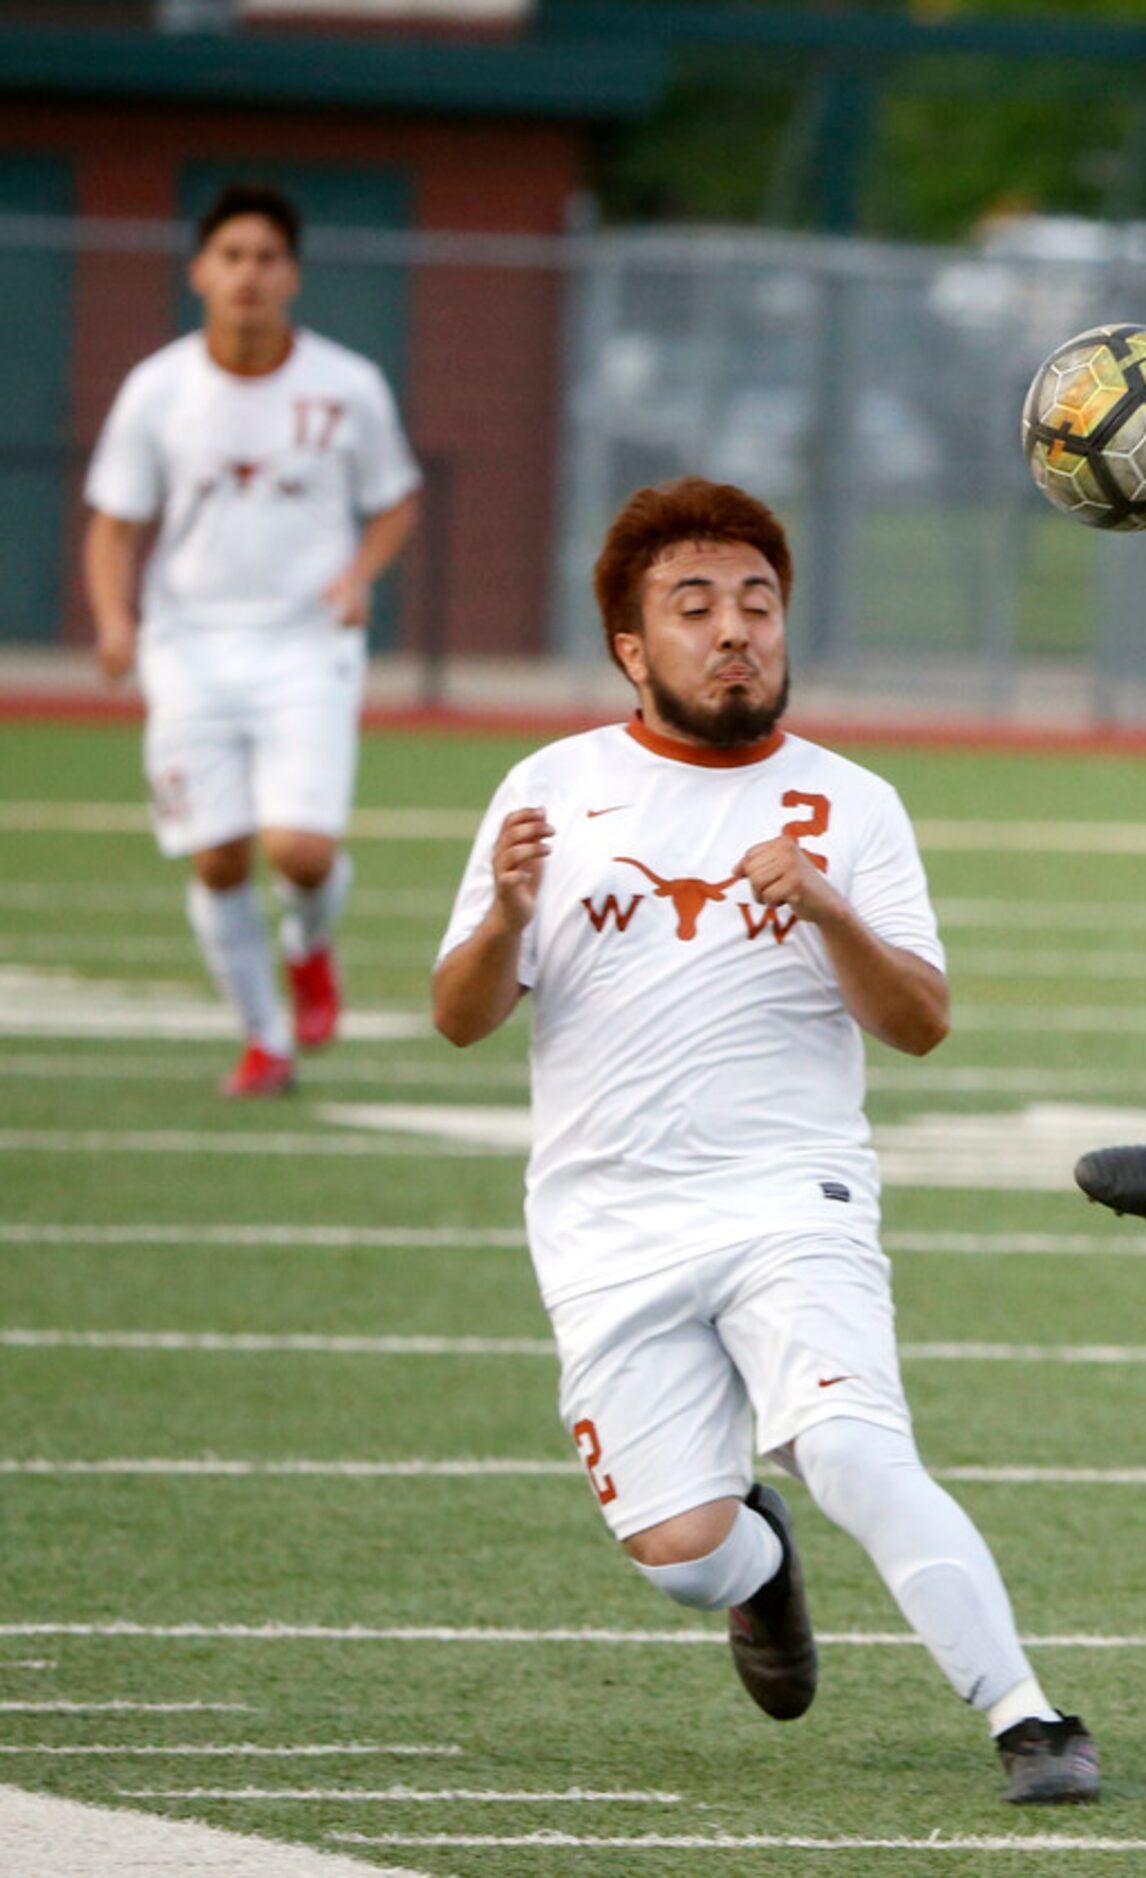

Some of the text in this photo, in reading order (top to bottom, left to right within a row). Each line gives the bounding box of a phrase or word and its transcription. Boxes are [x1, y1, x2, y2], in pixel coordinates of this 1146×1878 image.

[292, 397, 342, 451] 17
[781, 790, 830, 874] 2
[580, 895, 799, 945] W W
[573, 1418, 617, 1504] 2
